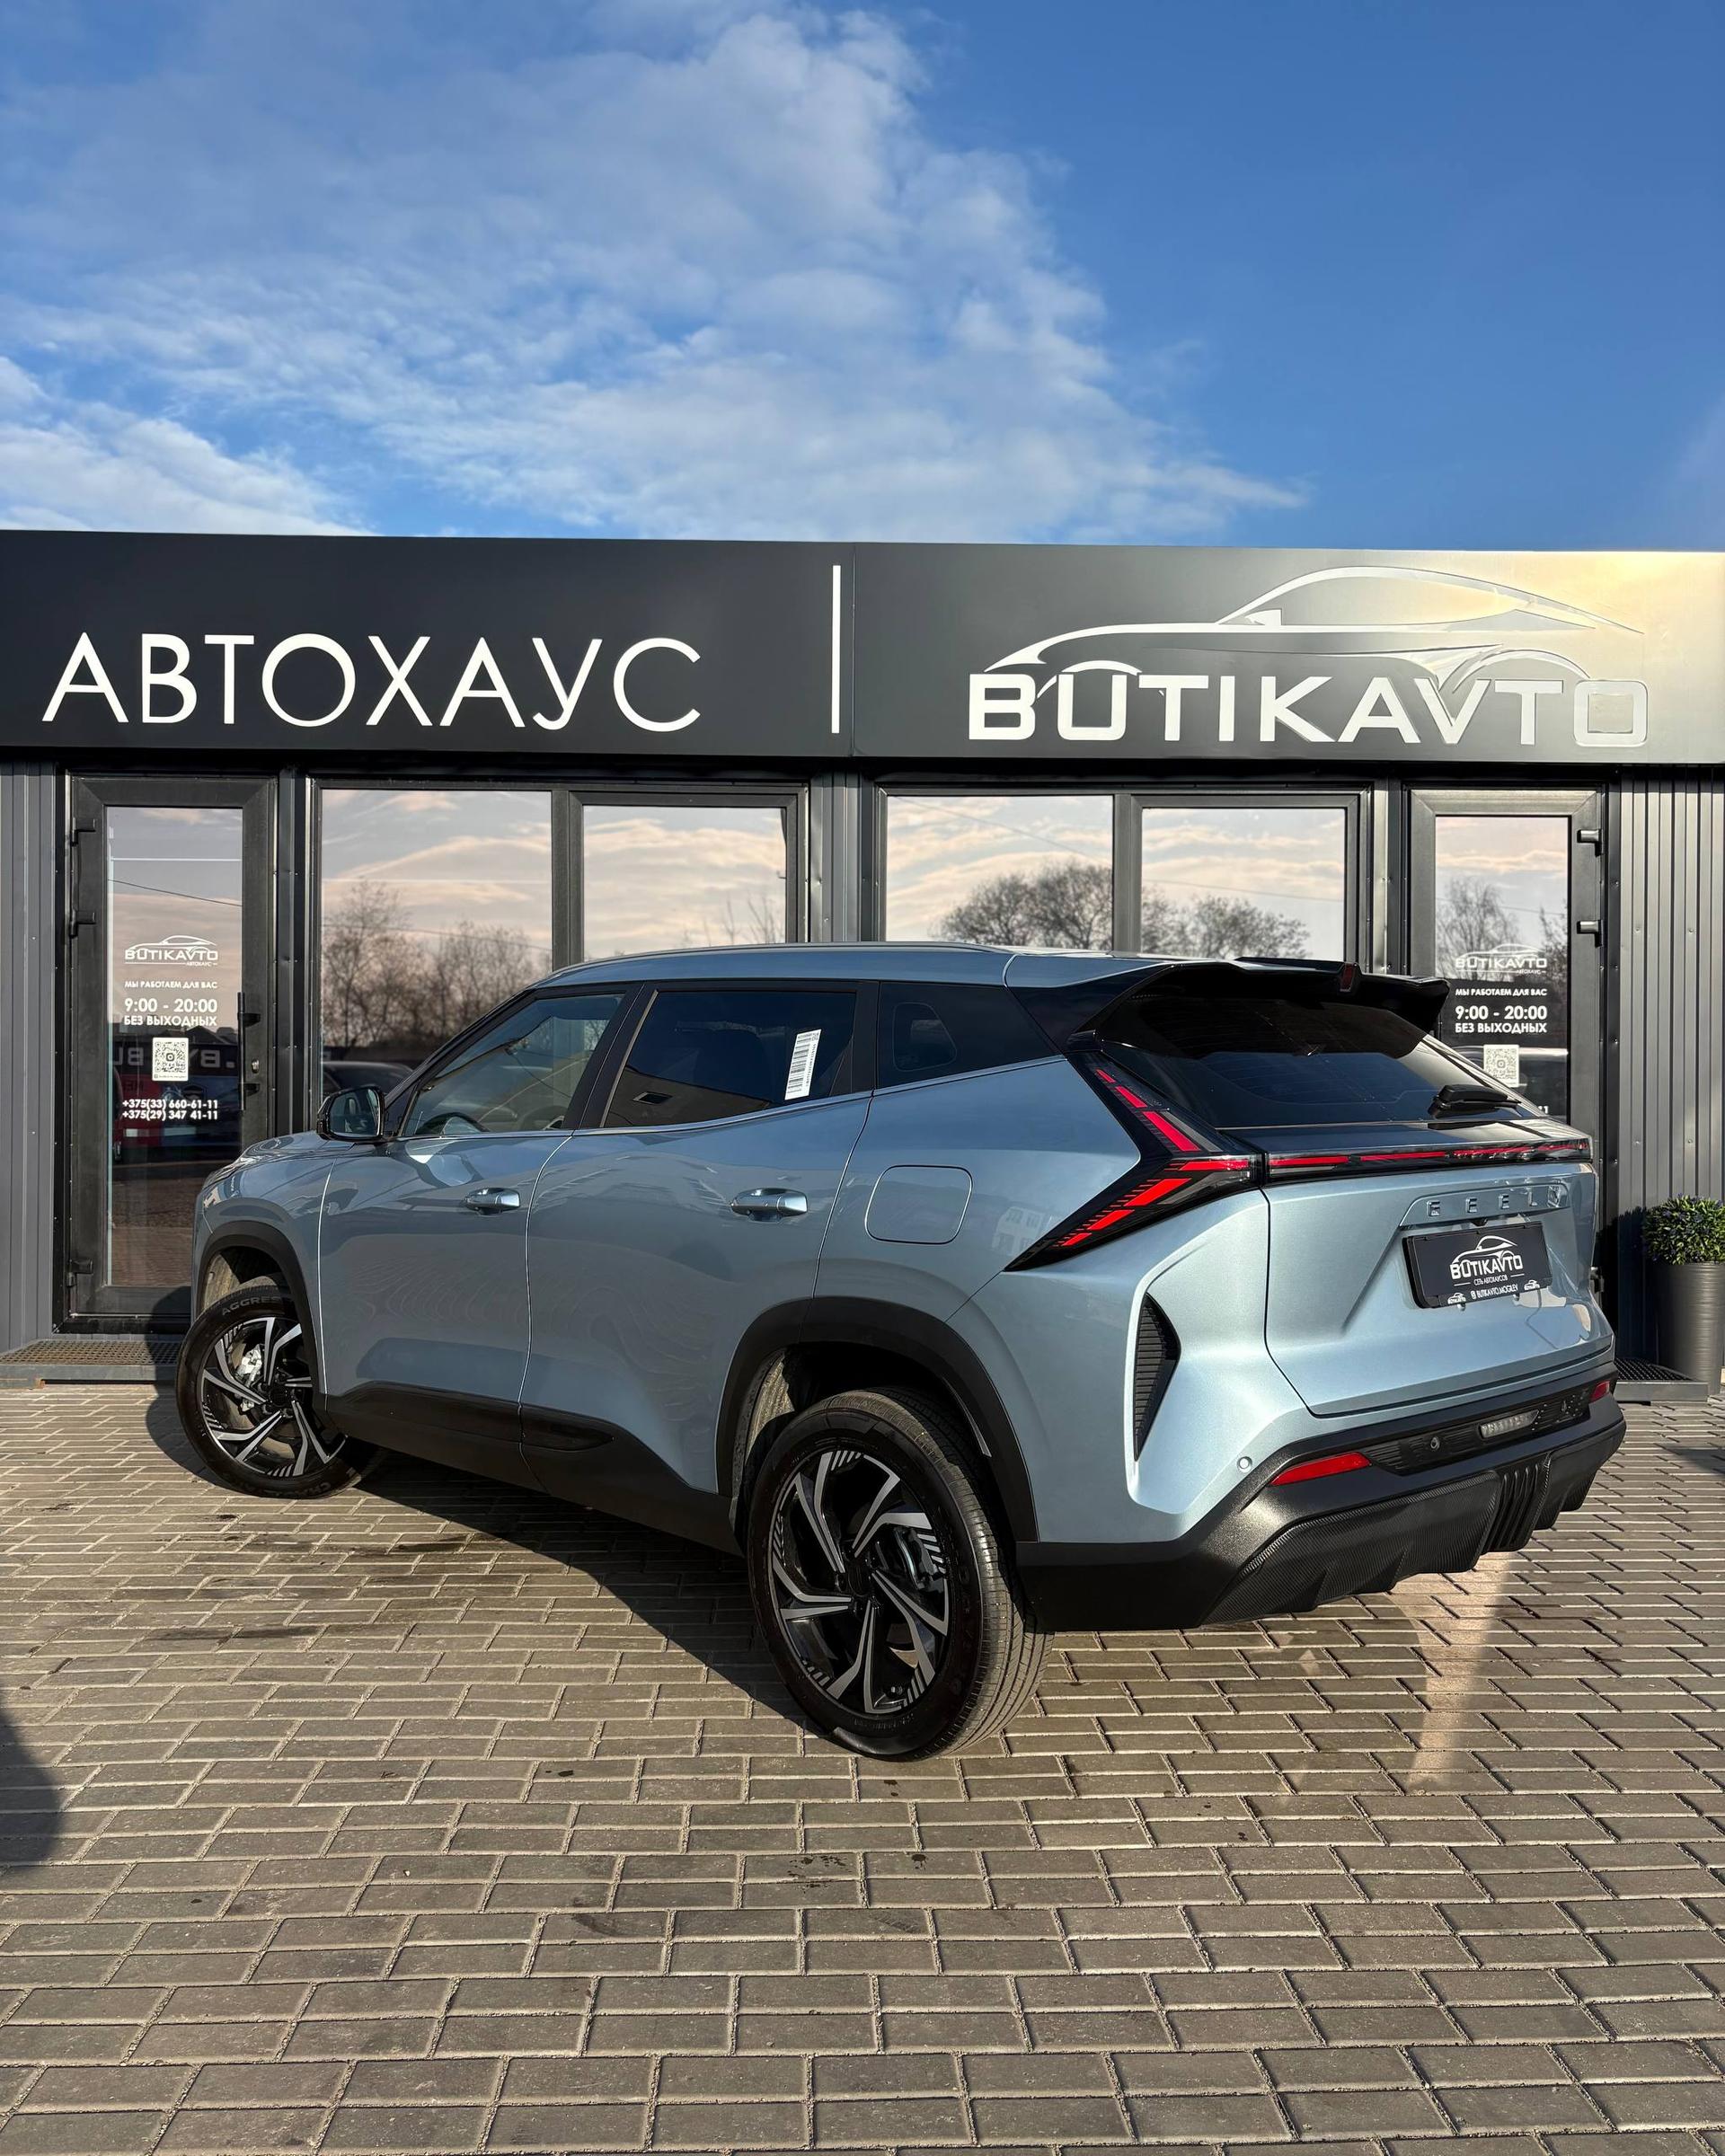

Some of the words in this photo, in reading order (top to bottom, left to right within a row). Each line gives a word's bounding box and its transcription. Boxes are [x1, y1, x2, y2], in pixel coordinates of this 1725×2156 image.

[42, 632, 702, 733] АВТОХАУС
[969, 673, 1649, 747] BUTIKAVTO
[125, 949, 218, 961] BUTIKAVTO
[1455, 958, 1547, 968] BUTIKAVTO
[182, 981, 199, 989] ДЛЯ
[124, 998, 157, 1012] 9:00
[174, 998, 217, 1012] 20:00
[1455, 1005, 1489, 1020] 9:00
[1504, 1005, 1547, 1020] 20:00
[124, 1015, 143, 1025] БЕЗ
[146, 1015, 217, 1027] ВЫХОДНЫХ
[1455, 1023, 1474, 1033] БЕЗ
[1478, 1022, 1547, 1034] ВЫХОДНЫХ
[122, 1100, 166, 1109] +375(33)
[169, 1100, 218, 1109] 660-61-11
[122, 1109, 166, 1120] +375(29)
[1449, 1254, 1524, 1280] BUTIKAVTO
